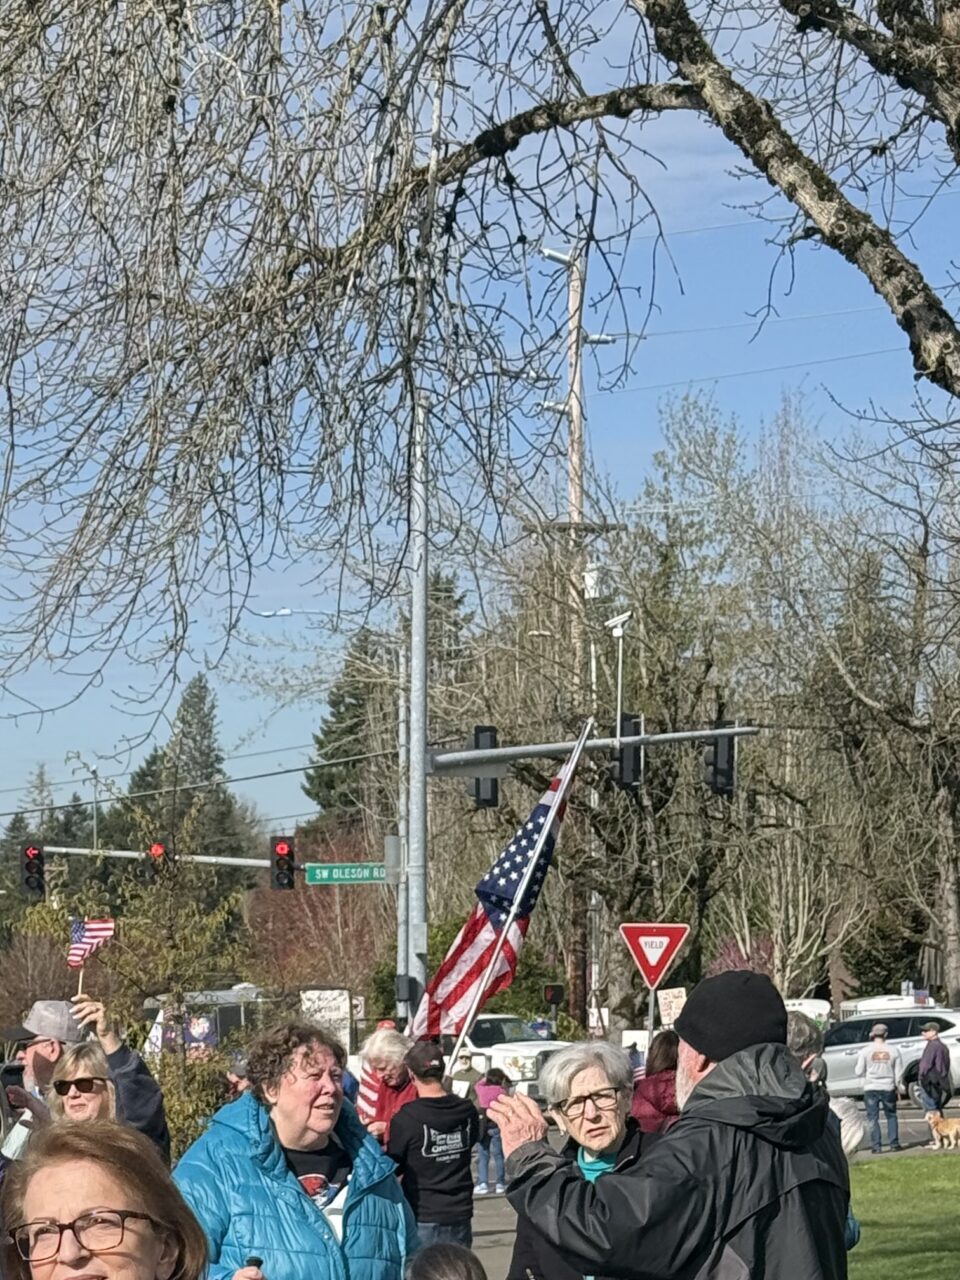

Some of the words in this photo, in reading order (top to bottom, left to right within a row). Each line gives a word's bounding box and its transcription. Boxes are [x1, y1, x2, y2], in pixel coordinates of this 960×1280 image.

[315, 869, 329, 879] SW
[332, 868, 370, 879] OLESON
[373, 867, 386, 878] RD
[644, 941, 664, 949] YIELD
